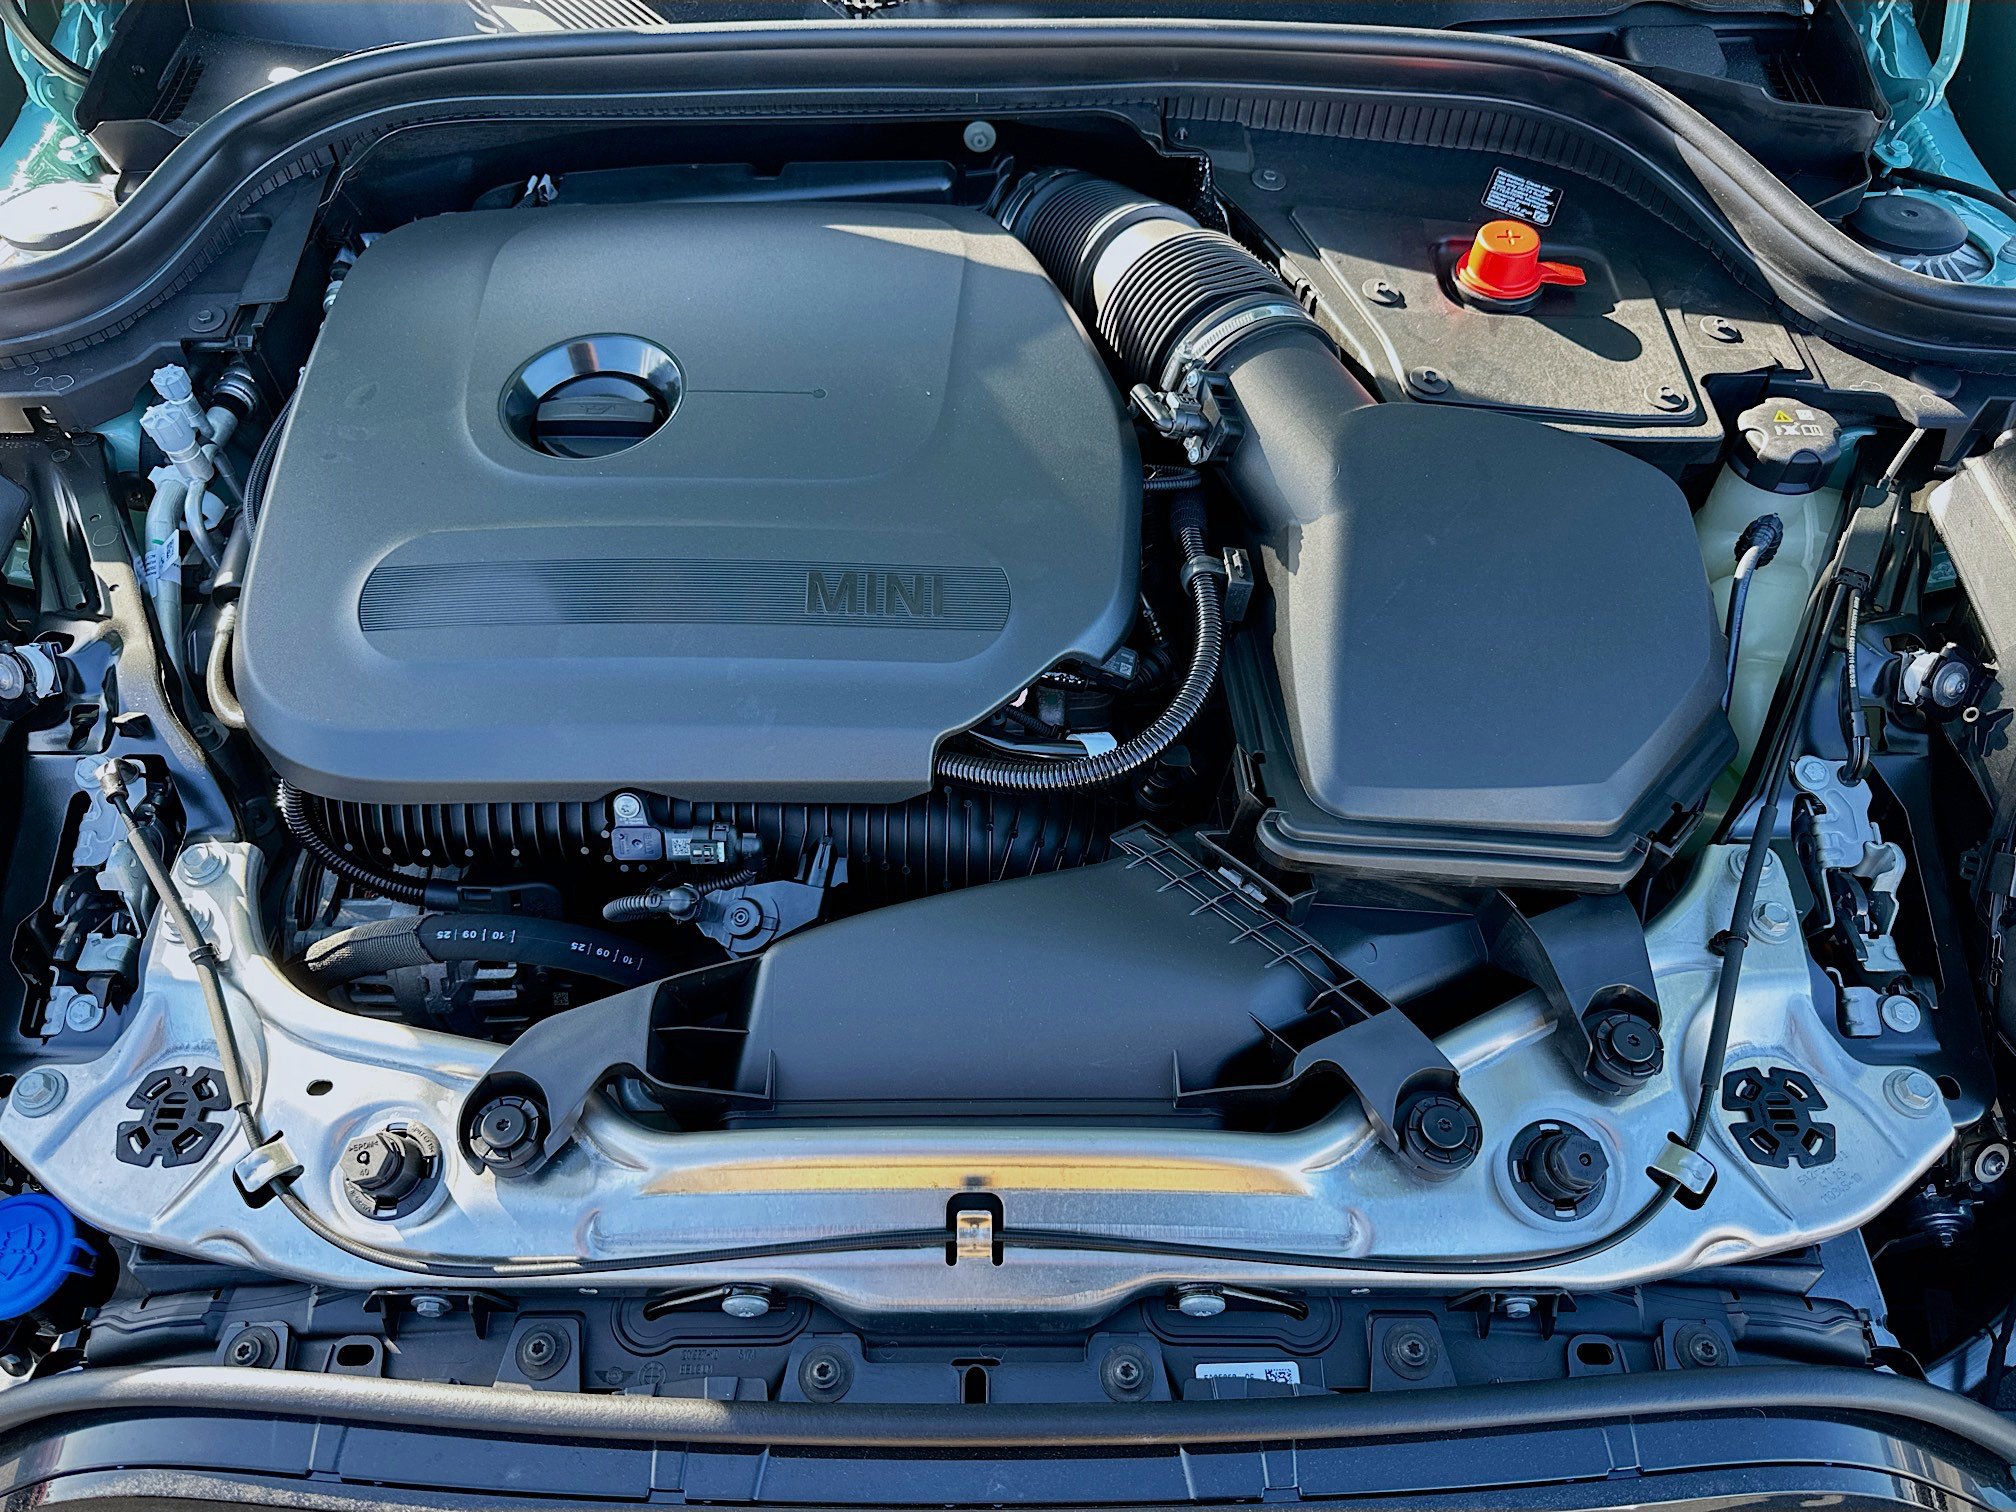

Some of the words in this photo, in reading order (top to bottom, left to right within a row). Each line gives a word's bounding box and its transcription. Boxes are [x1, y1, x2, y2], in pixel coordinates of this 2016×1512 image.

[806, 572, 944, 617] MINI
[436, 930, 452, 939] 25
[462, 930, 477, 939] 09
[492, 931, 505, 940] 10
[571, 942, 586, 952] 25
[596, 948, 610, 957] 09
[623, 956, 633, 965] 10
